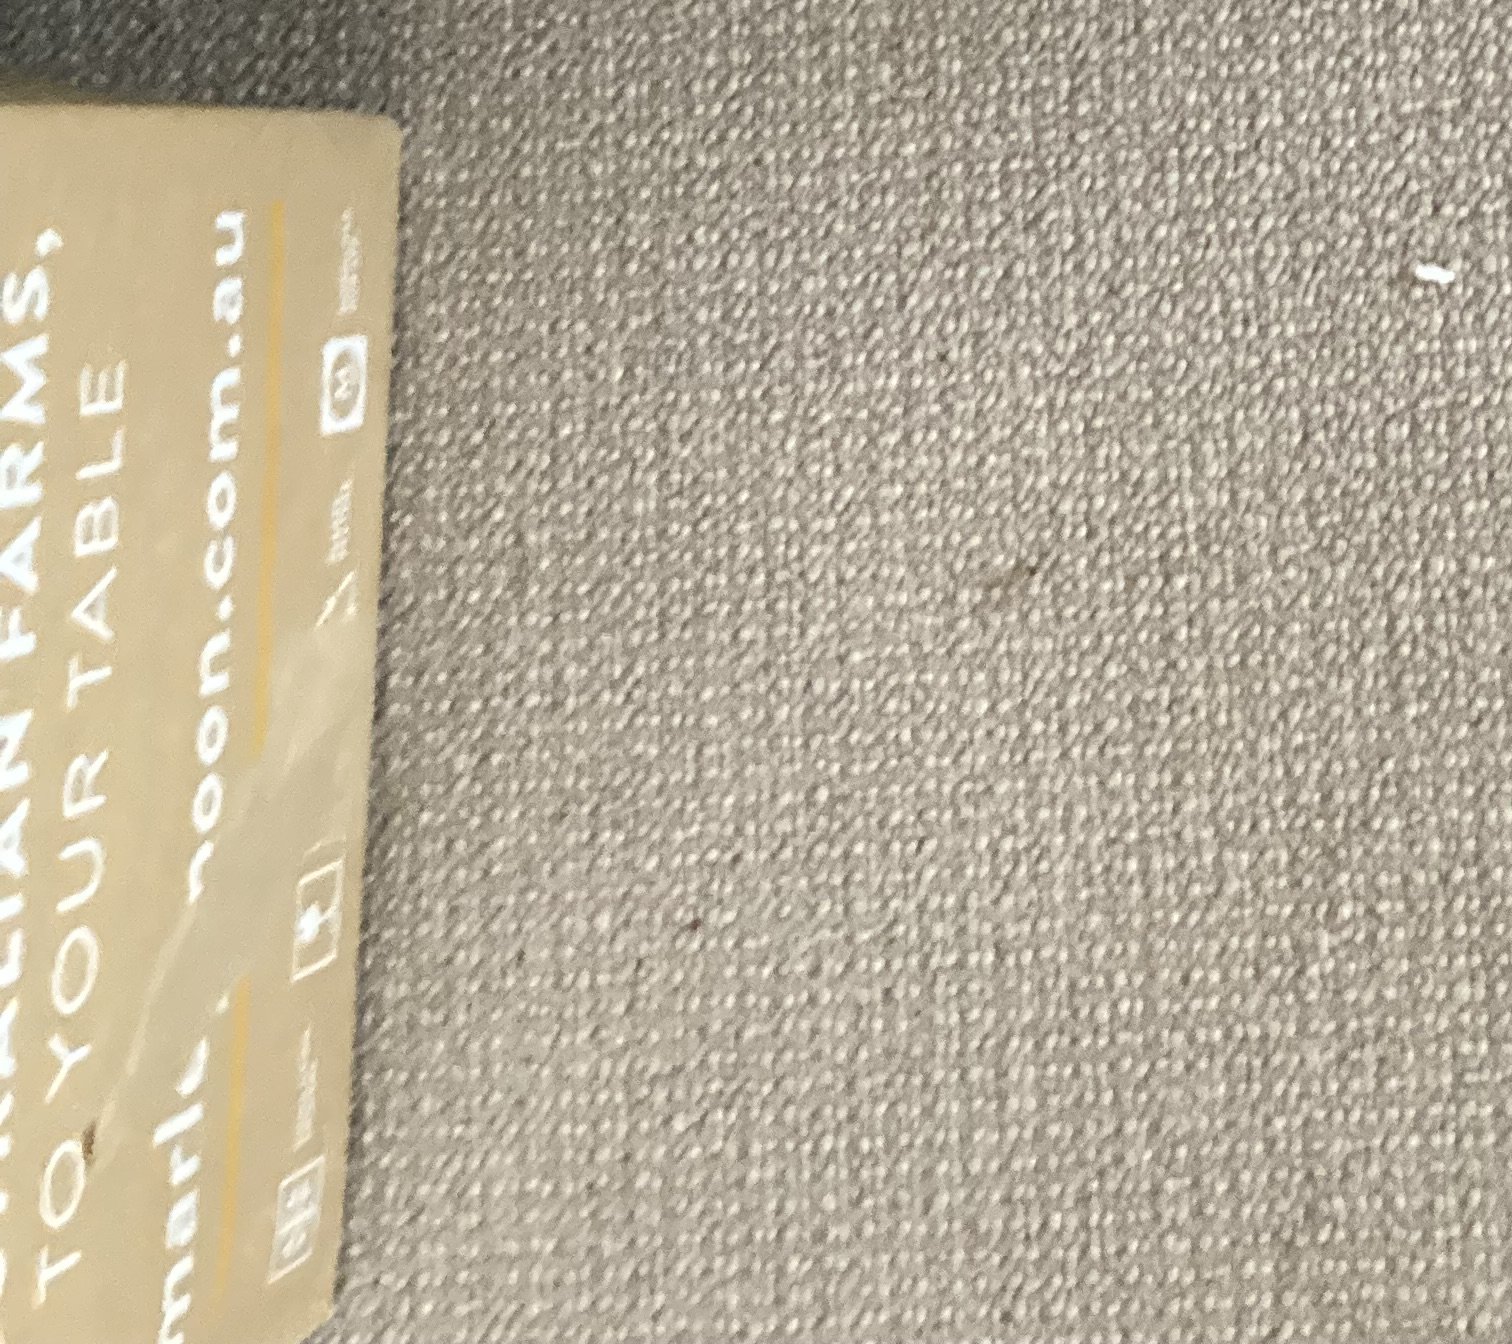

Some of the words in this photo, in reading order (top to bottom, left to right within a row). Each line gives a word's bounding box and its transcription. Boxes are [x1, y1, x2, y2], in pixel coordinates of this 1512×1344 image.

[0, 227, 64, 663] FARMS,
[66, 358, 128, 713] TABLE
[44, 748, 110, 1104] YOUR
[31, 1138, 88, 1311] TO
